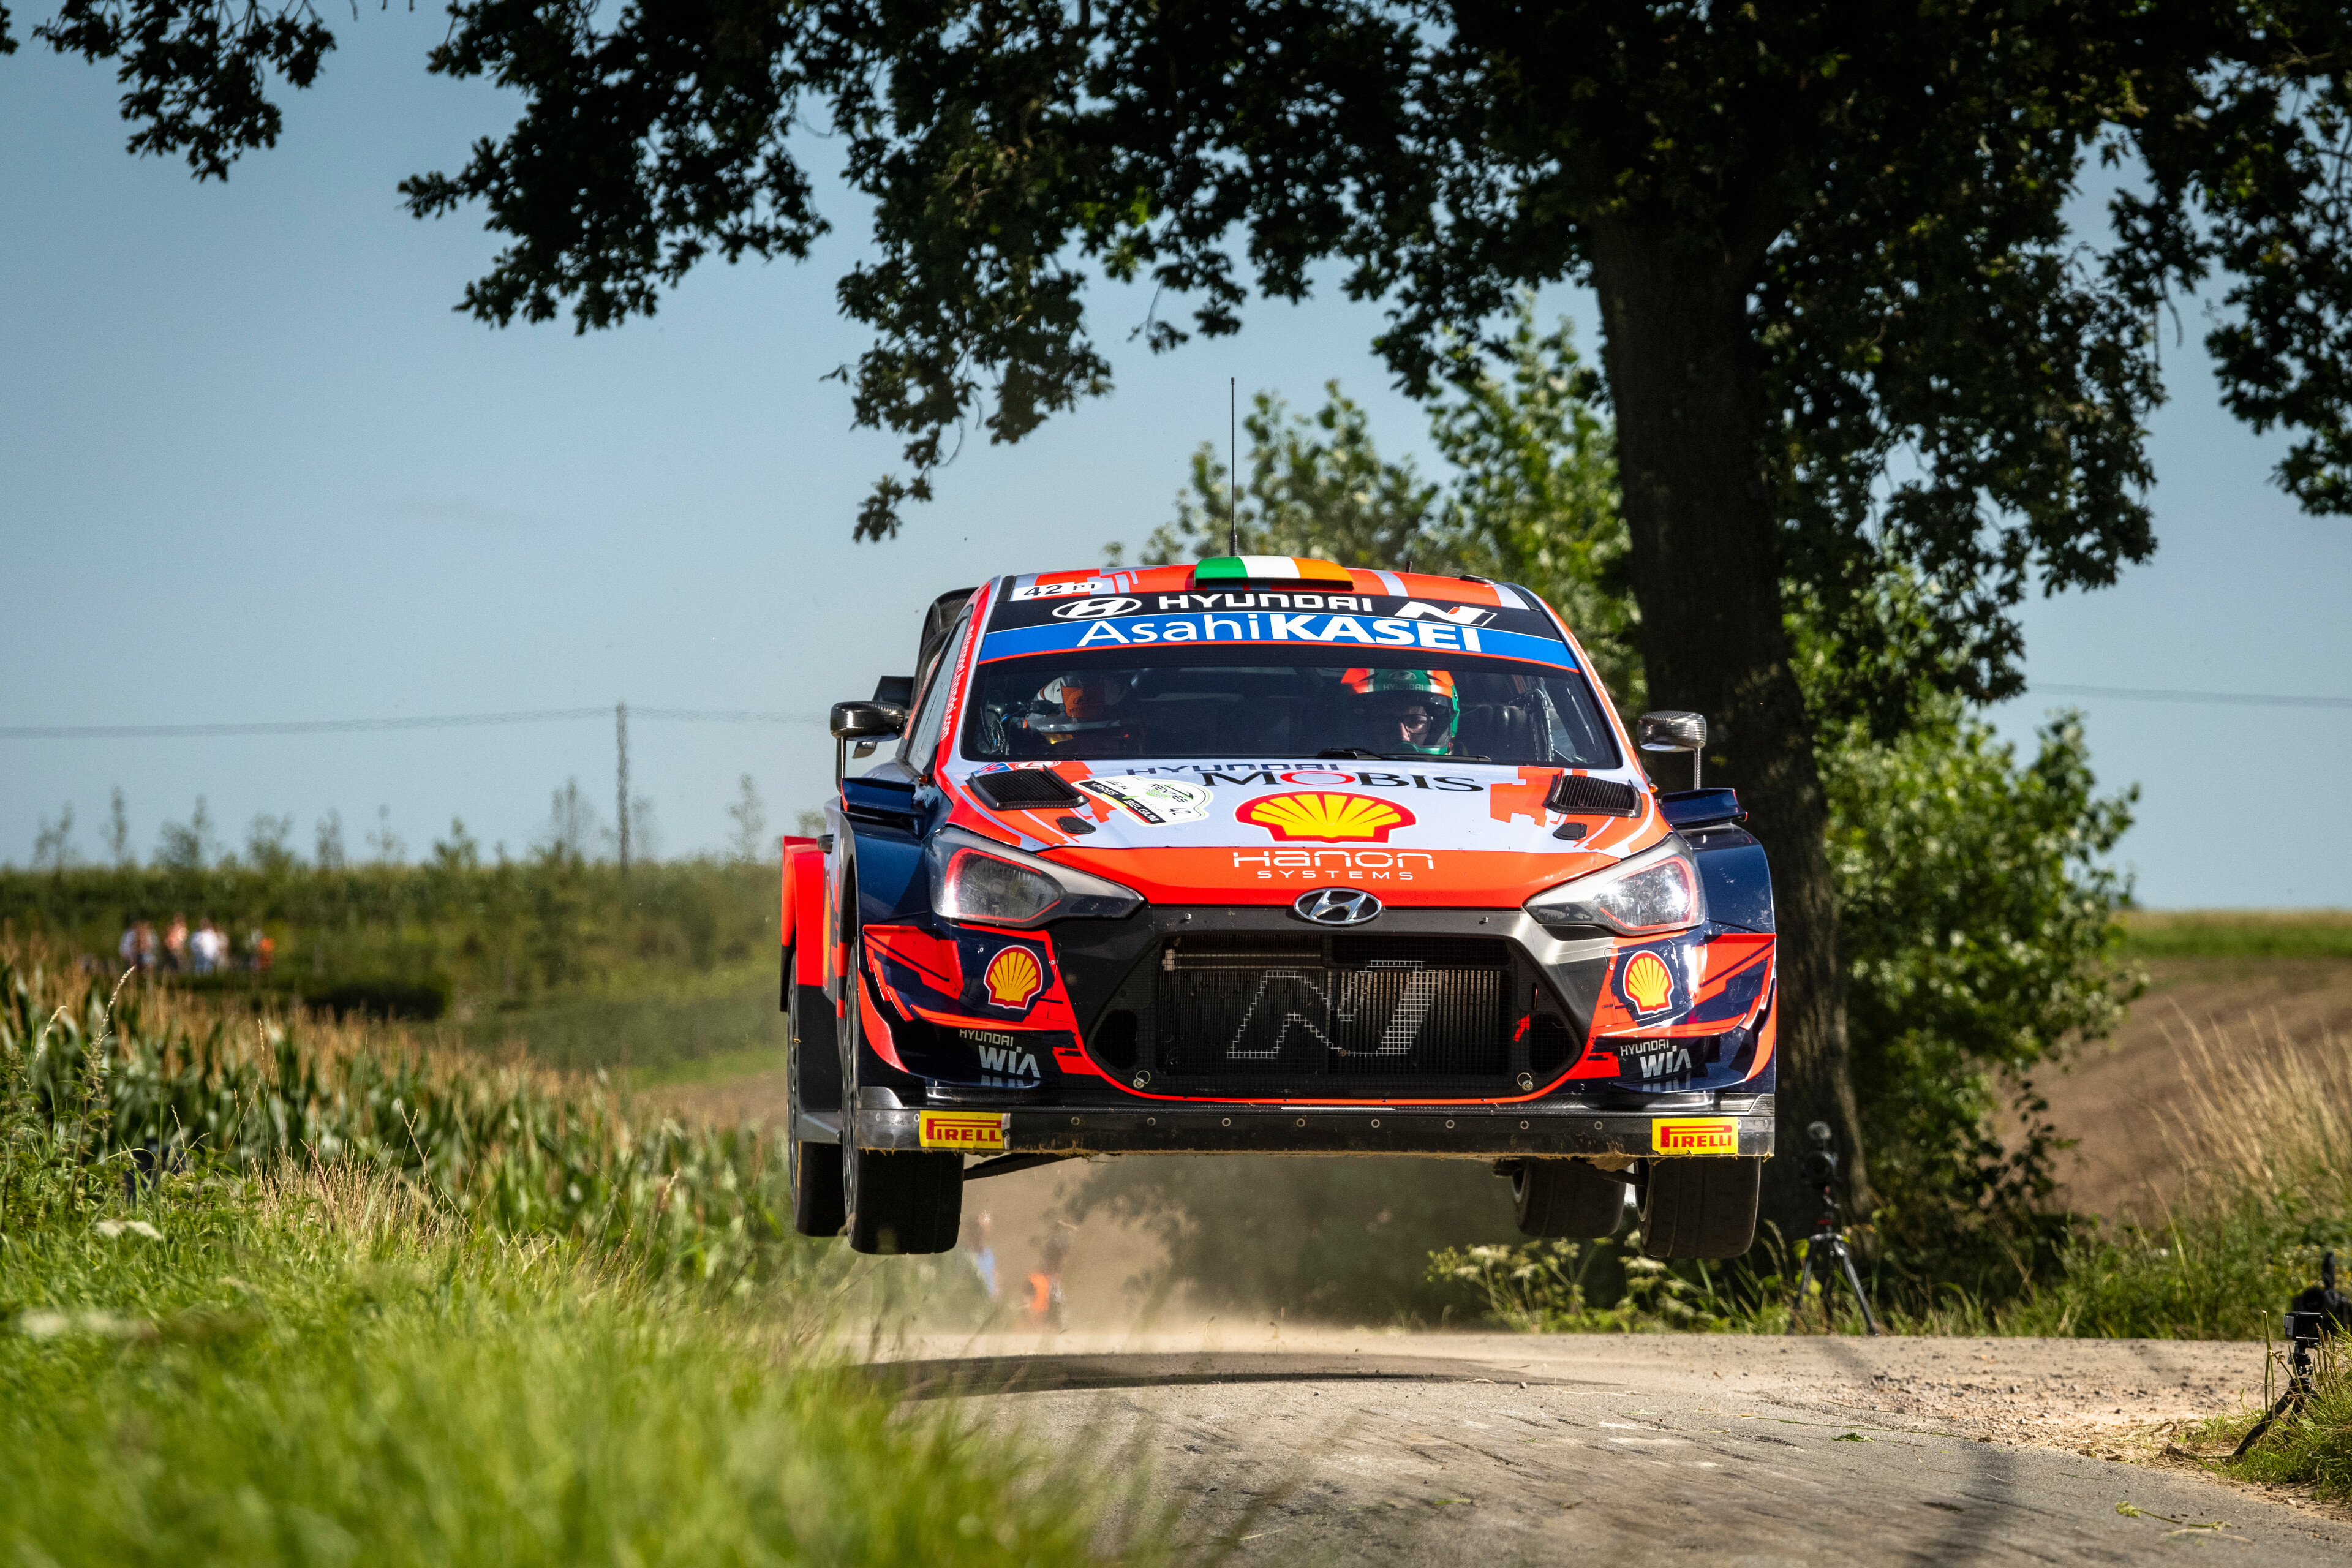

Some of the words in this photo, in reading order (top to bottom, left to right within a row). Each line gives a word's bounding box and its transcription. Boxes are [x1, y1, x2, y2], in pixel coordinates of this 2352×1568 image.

[1023, 584, 1063, 597] 42
[1158, 593, 1373, 612] HYUNDAI
[1126, 763, 1340, 776] HYUNDAI
[1203, 771, 1485, 792] MOBIS
[1090, 783, 1119, 796] YPRES
[1123, 799, 1160, 822] BELGIUM
[1169, 807, 1191, 816] 42
[1257, 870, 1414, 880] SYSTEMS
[959, 1028, 1014, 1047] HYUNDAI
[1619, 1039, 1670, 1057] HYUNDAI
[925, 1118, 1003, 1142] PIRELL
[1660, 1125, 1733, 1148] PIRELLI
